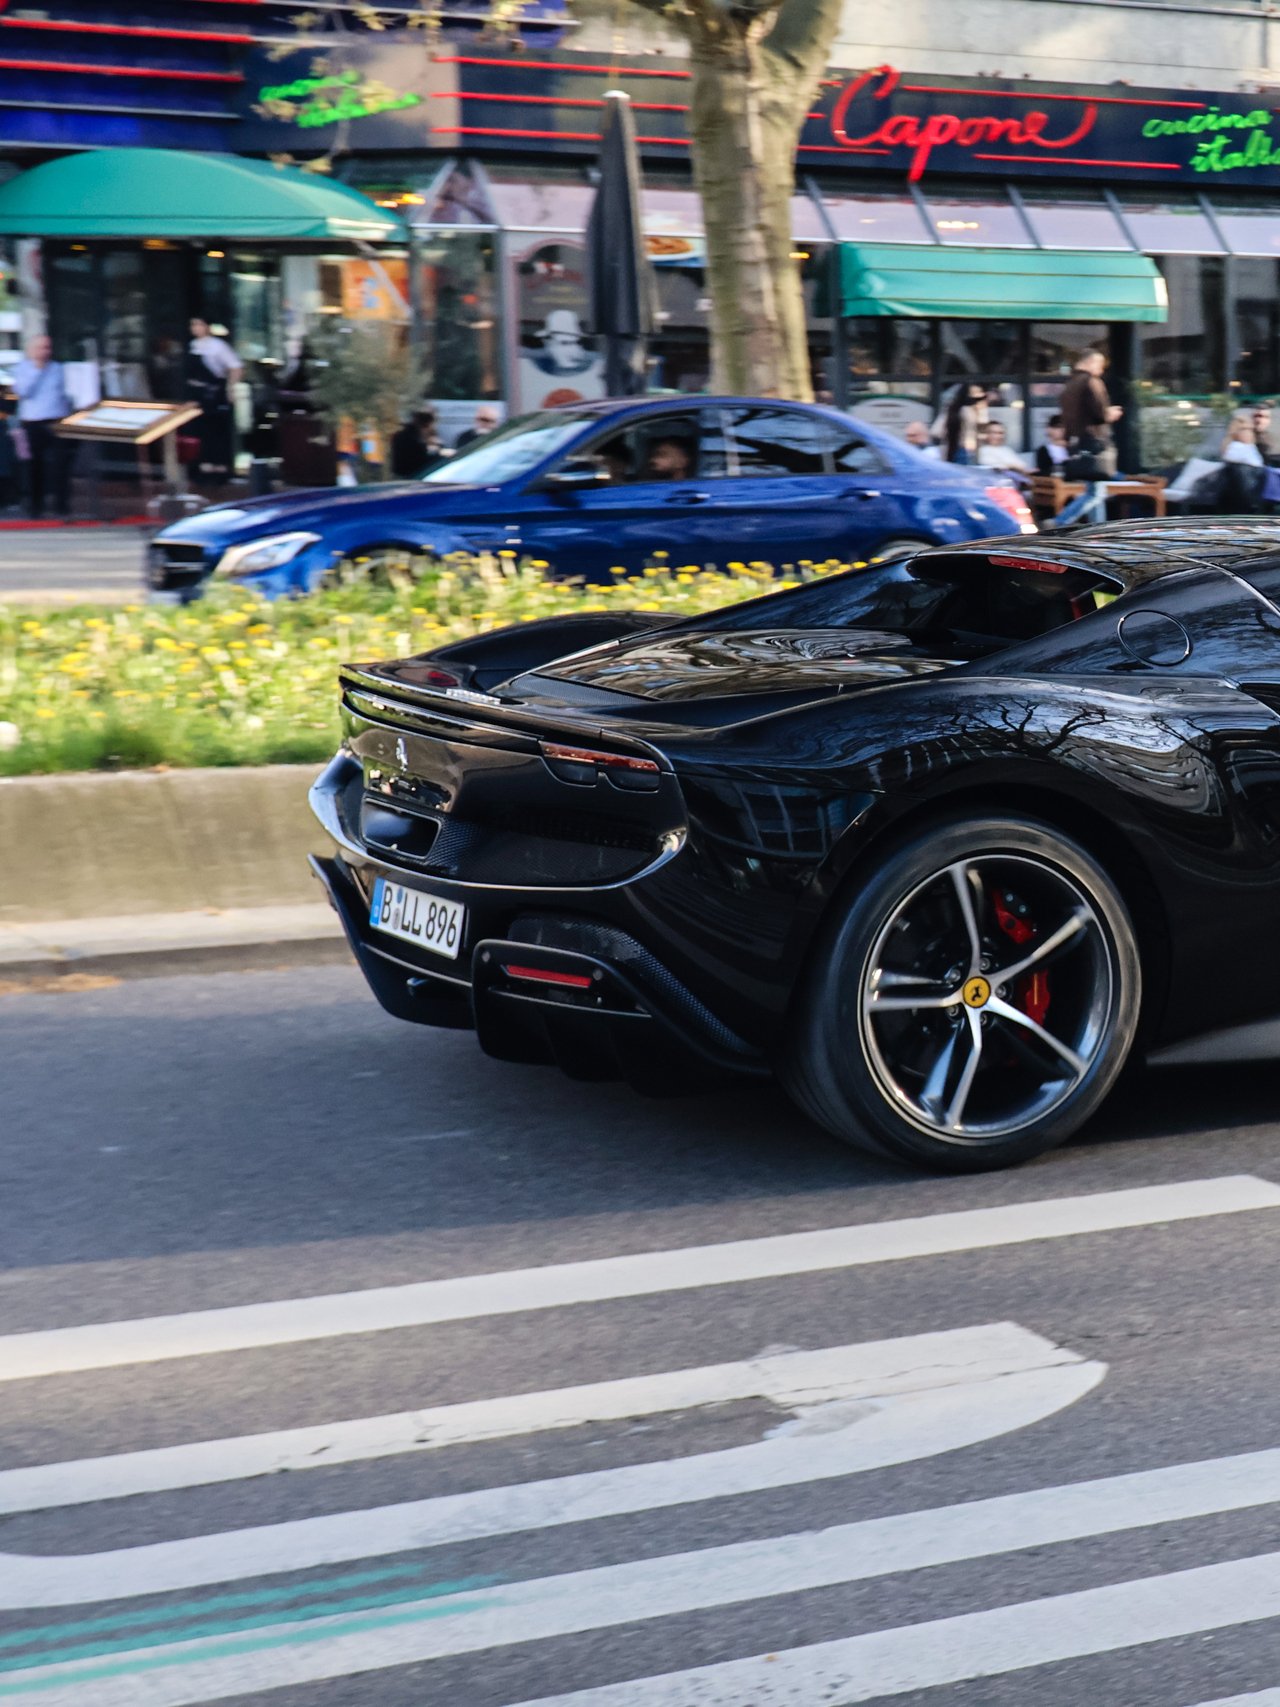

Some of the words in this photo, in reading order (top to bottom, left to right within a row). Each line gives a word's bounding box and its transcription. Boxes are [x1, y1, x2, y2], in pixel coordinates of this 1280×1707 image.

[831, 65, 1098, 183] Capone
[381, 885, 393, 923] B
[401, 892, 422, 936] LL
[425, 901, 458, 948] 896
